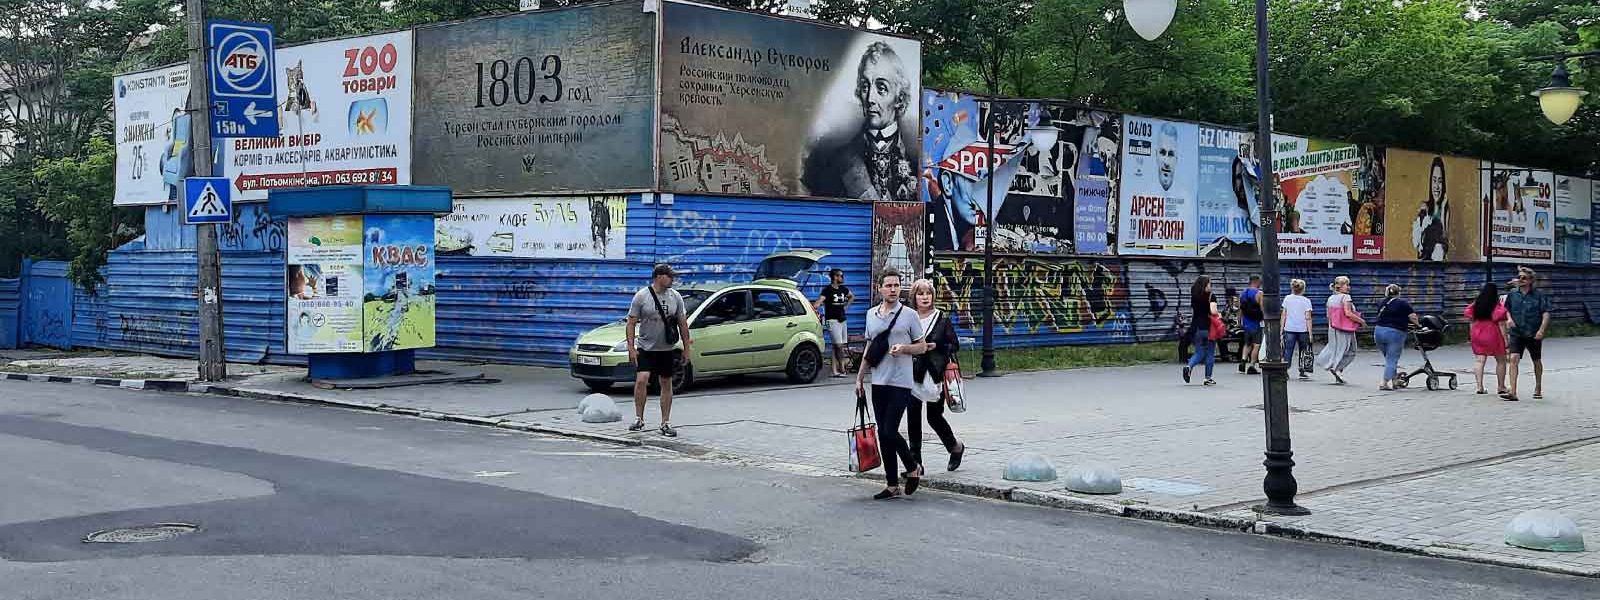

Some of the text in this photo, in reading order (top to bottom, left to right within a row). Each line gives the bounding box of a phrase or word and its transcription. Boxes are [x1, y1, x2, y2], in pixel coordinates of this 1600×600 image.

[224, 53, 258, 70] АТБ
[343, 43, 398, 78] ZOO
[342, 75, 397, 95] товари
[474, 55, 592, 109] 1803 год
[1128, 120, 1152, 138] 06/03
[235, 133, 321, 151] ВЕЛИКИЙ ВИБІР
[234, 151, 263, 167] КОРМІВ
[324, 143, 397, 162] АКВАРІУМІСТИКА
[335, 173, 350, 184] 063
[352, 173, 367, 183] 692
[381, 170, 393, 182] 34
[1130, 195, 1165, 217] АРСЕН
[1138, 219, 1185, 240] МІРЗОЯН
[372, 244, 428, 266] КВАС
